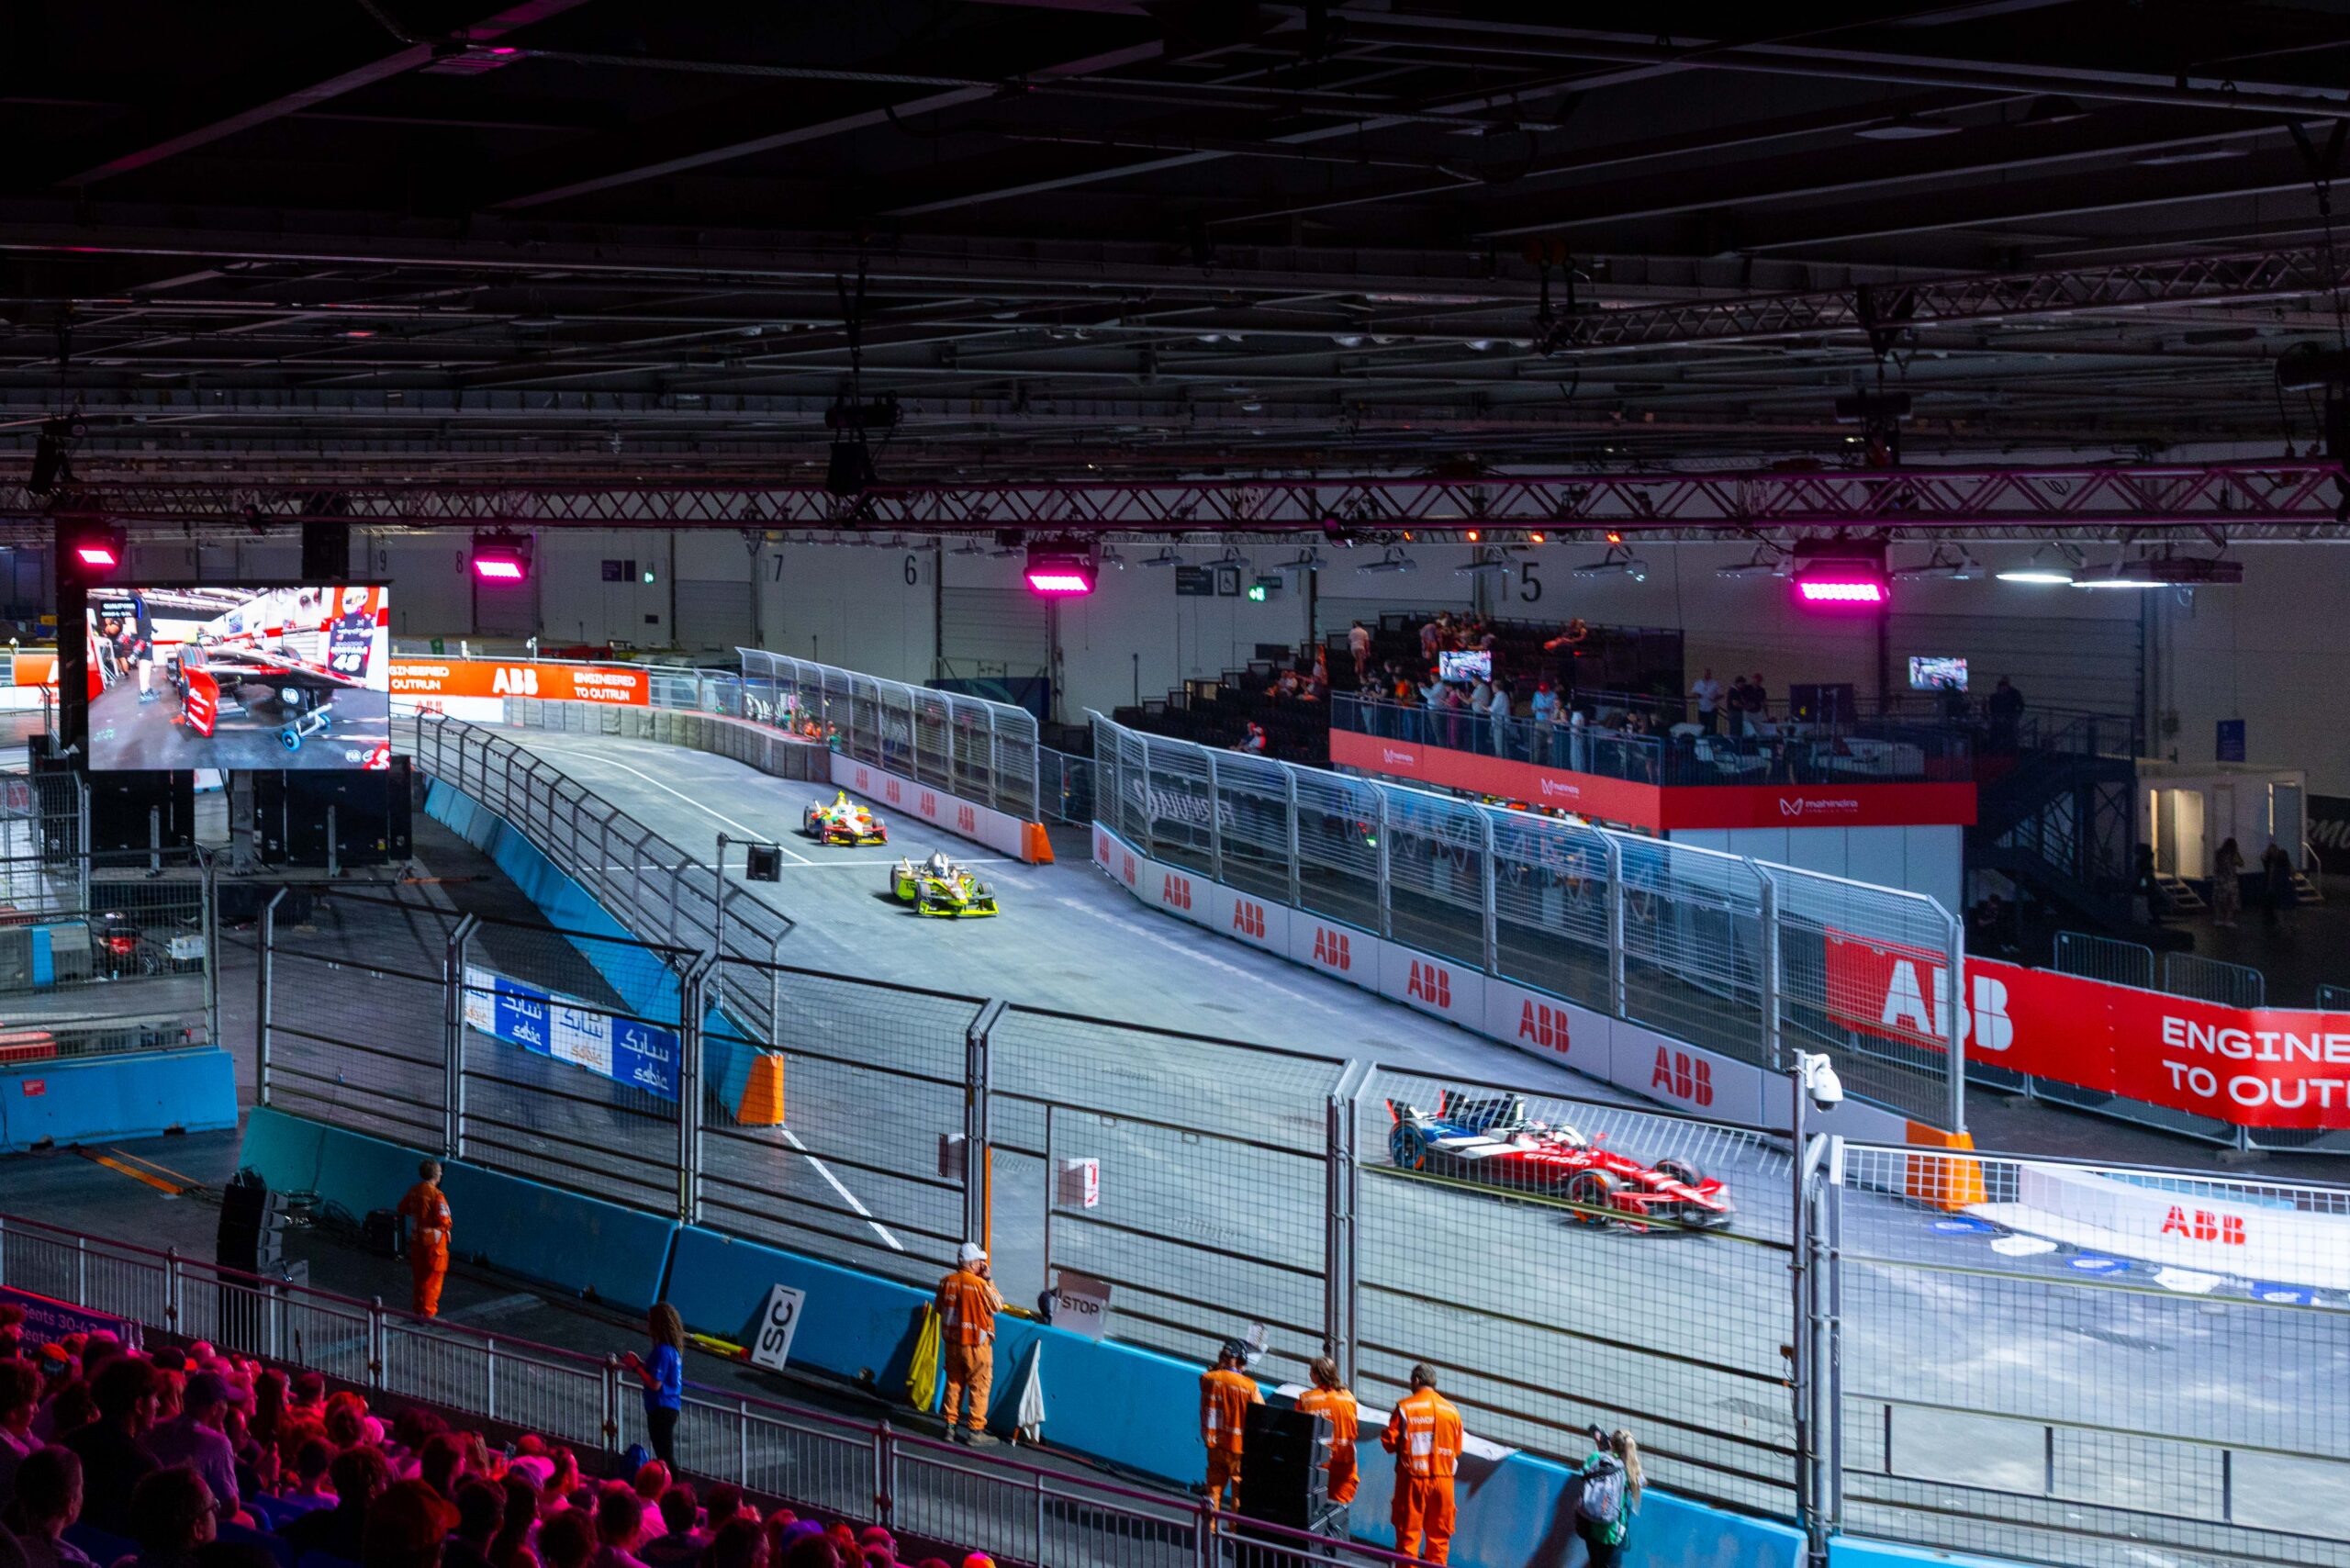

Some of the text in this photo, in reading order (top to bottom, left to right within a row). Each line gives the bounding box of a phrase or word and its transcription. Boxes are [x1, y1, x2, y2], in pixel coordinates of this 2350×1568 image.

[379, 549, 386, 572] 9
[455, 551, 464, 574] 8
[773, 554, 784, 582] 7
[904, 554, 917, 586] 6
[1520, 562, 1542, 602] 5
[392, 678, 442, 690] OUTRUN
[492, 667, 539, 696] ABB
[573, 672, 637, 688] ENGINEERED
[575, 687, 630, 701] TO OUTRUN
[887, 778, 901, 804] ABB
[921, 790, 935, 818] ABB
[1805, 799, 1859, 808] mahindra
[957, 804, 975, 834] ABB
[1163, 873, 1192, 911] ABB
[1234, 897, 1266, 939] ABB
[1314, 926, 1351, 971] ABB
[1407, 959, 1451, 1009] ABB
[1882, 959, 2014, 1052] ABB
[512, 1021, 543, 1047] sabic
[1519, 999, 1571, 1054] ABB
[2162, 1015, 2350, 1063] ENGINE
[571, 1041, 604, 1067] sabic
[632, 1062, 670, 1092] sabic
[1651, 1045, 1714, 1107] ABB
[2162, 1059, 2350, 1109] TO OUT
[2161, 1205, 2246, 1246] ABB
[20, 1302, 55, 1327] Seats
[1062, 1295, 1100, 1316] STOP
